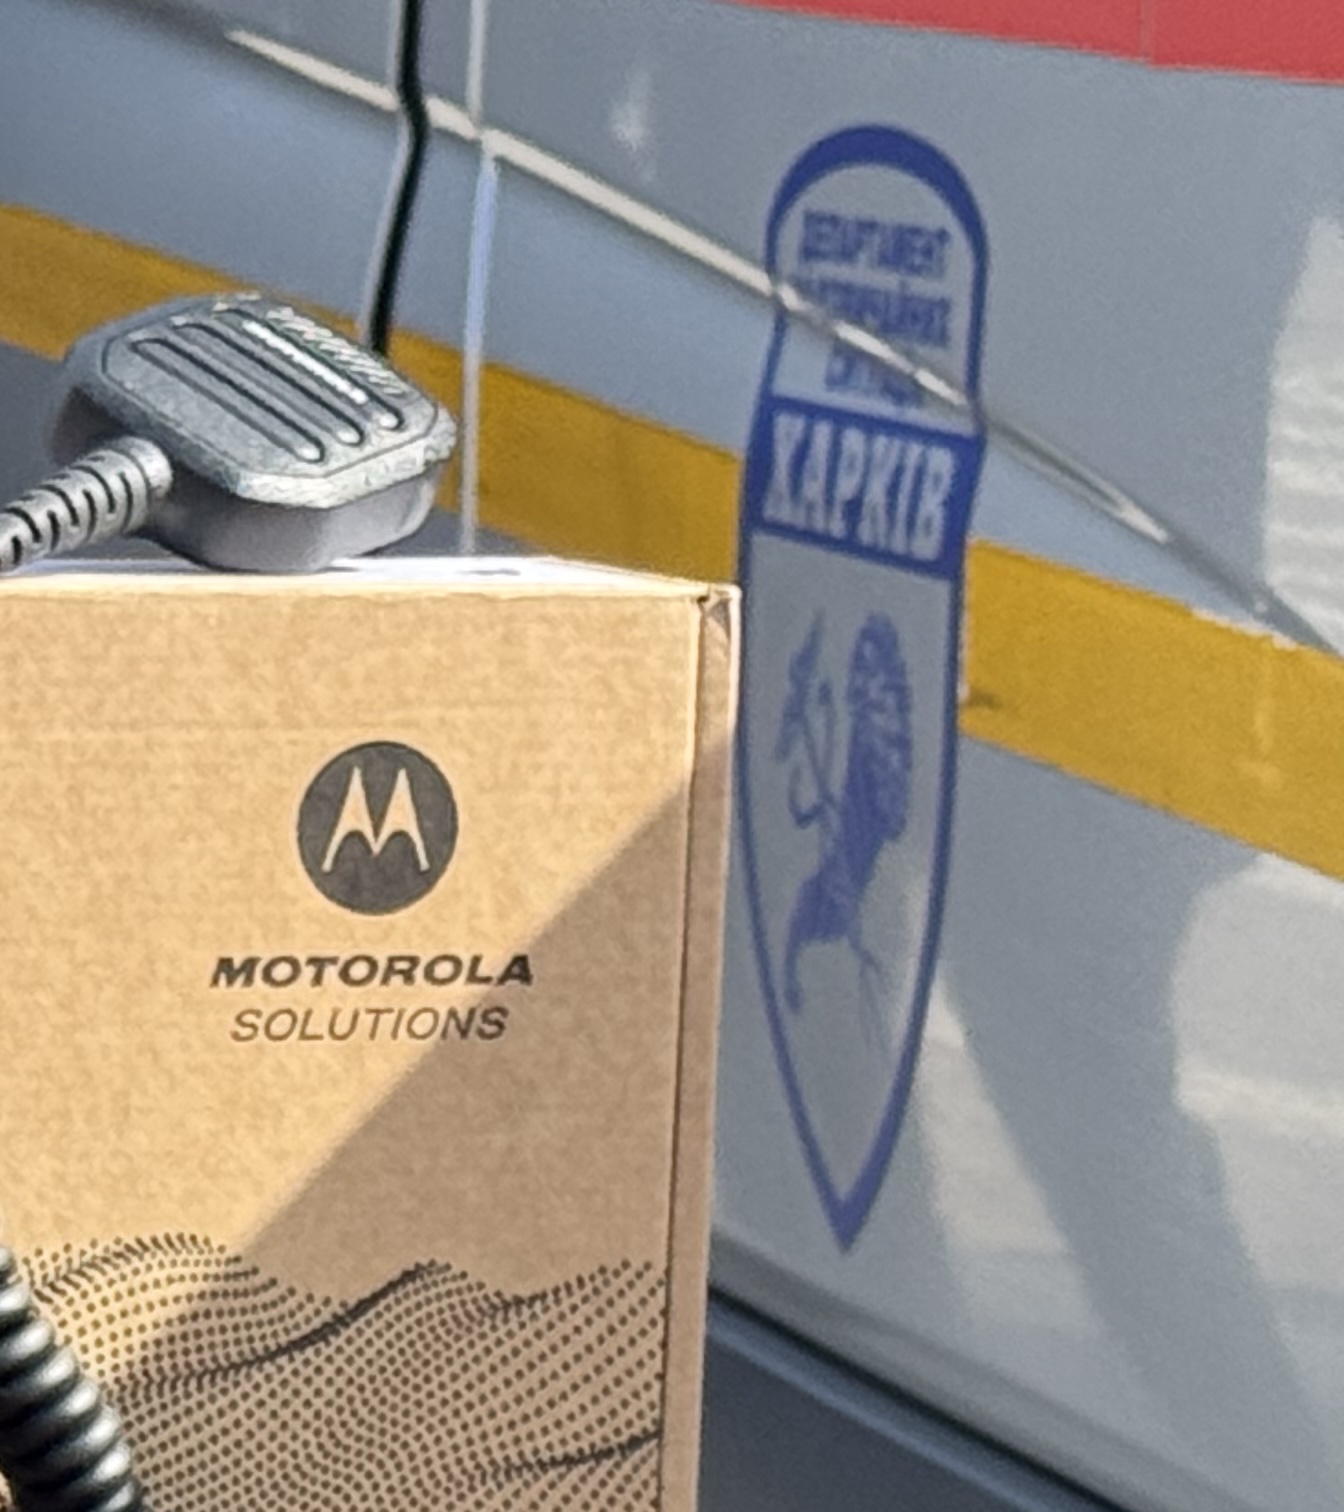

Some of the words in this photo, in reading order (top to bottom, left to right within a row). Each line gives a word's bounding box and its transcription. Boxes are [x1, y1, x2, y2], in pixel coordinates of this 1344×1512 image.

[761, 411, 954, 563] ХАРКІВ
[210, 953, 534, 989] MOTOROLA
[229, 1005, 510, 1043] SOLUTIONS
